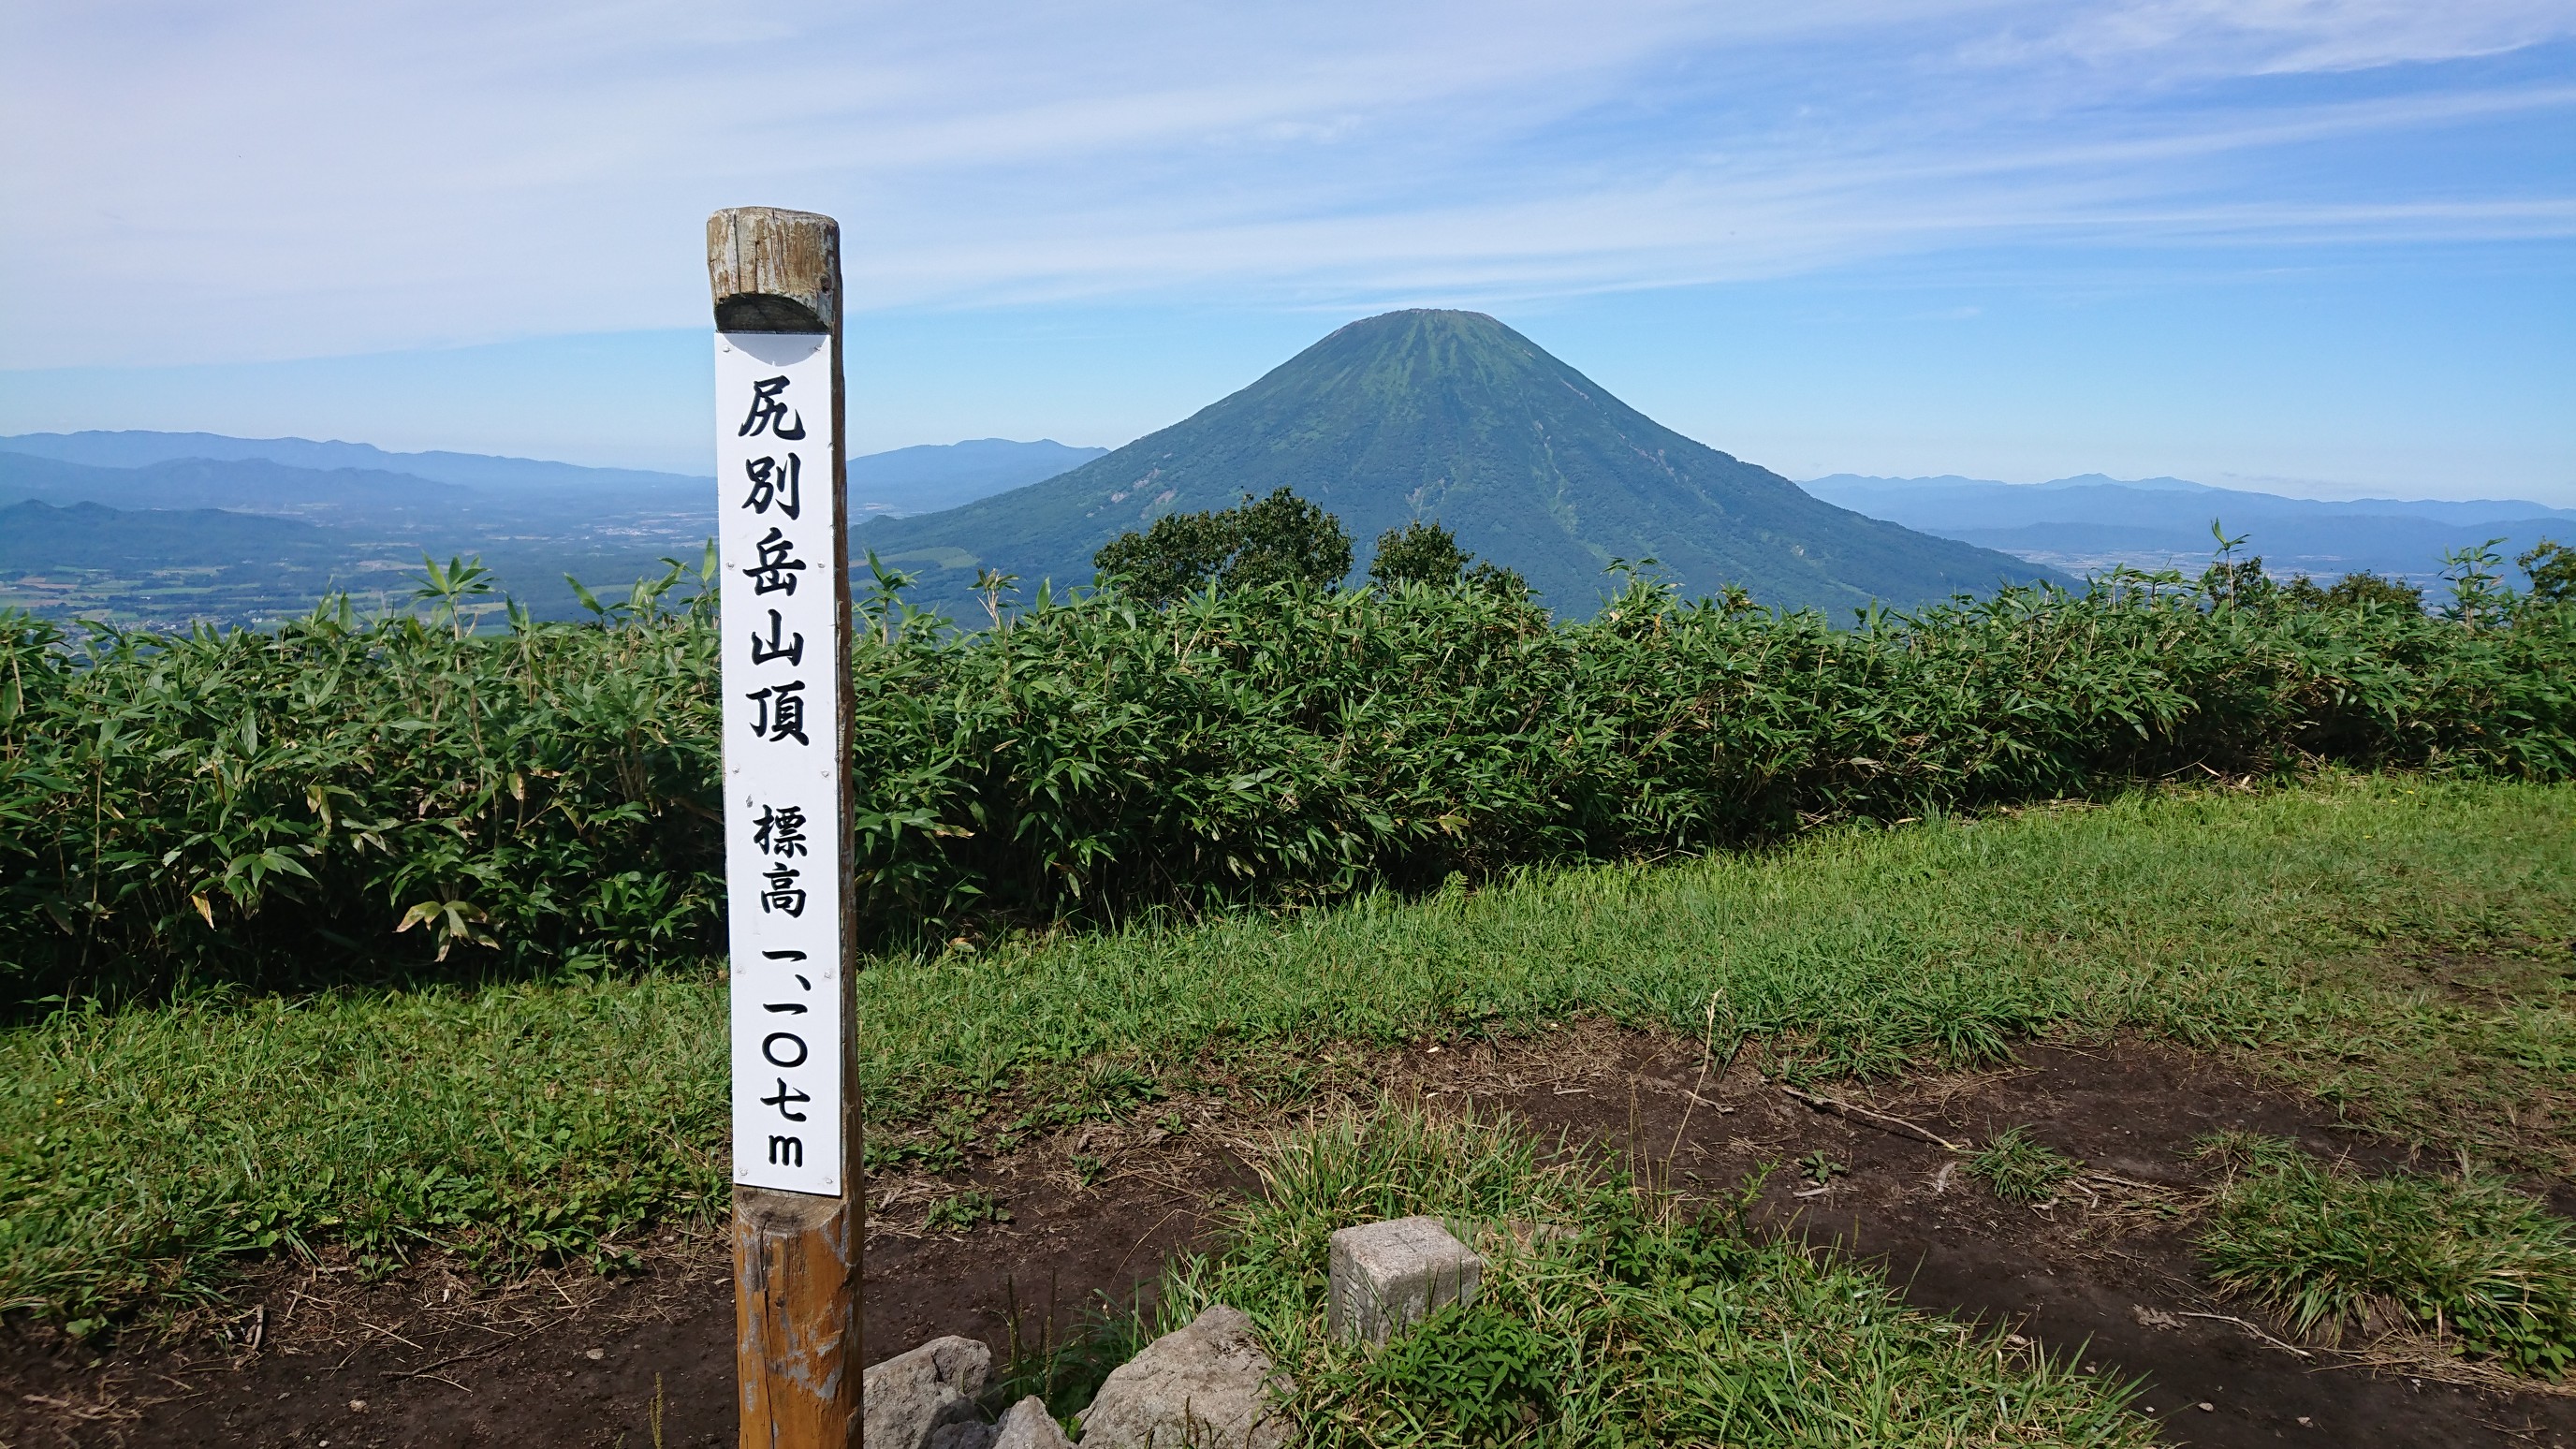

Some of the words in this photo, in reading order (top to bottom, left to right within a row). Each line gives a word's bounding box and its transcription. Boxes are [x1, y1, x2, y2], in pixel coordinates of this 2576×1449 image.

[739, 375, 809, 746] 尻別岳山頂
[753, 804, 808, 918] 標高
